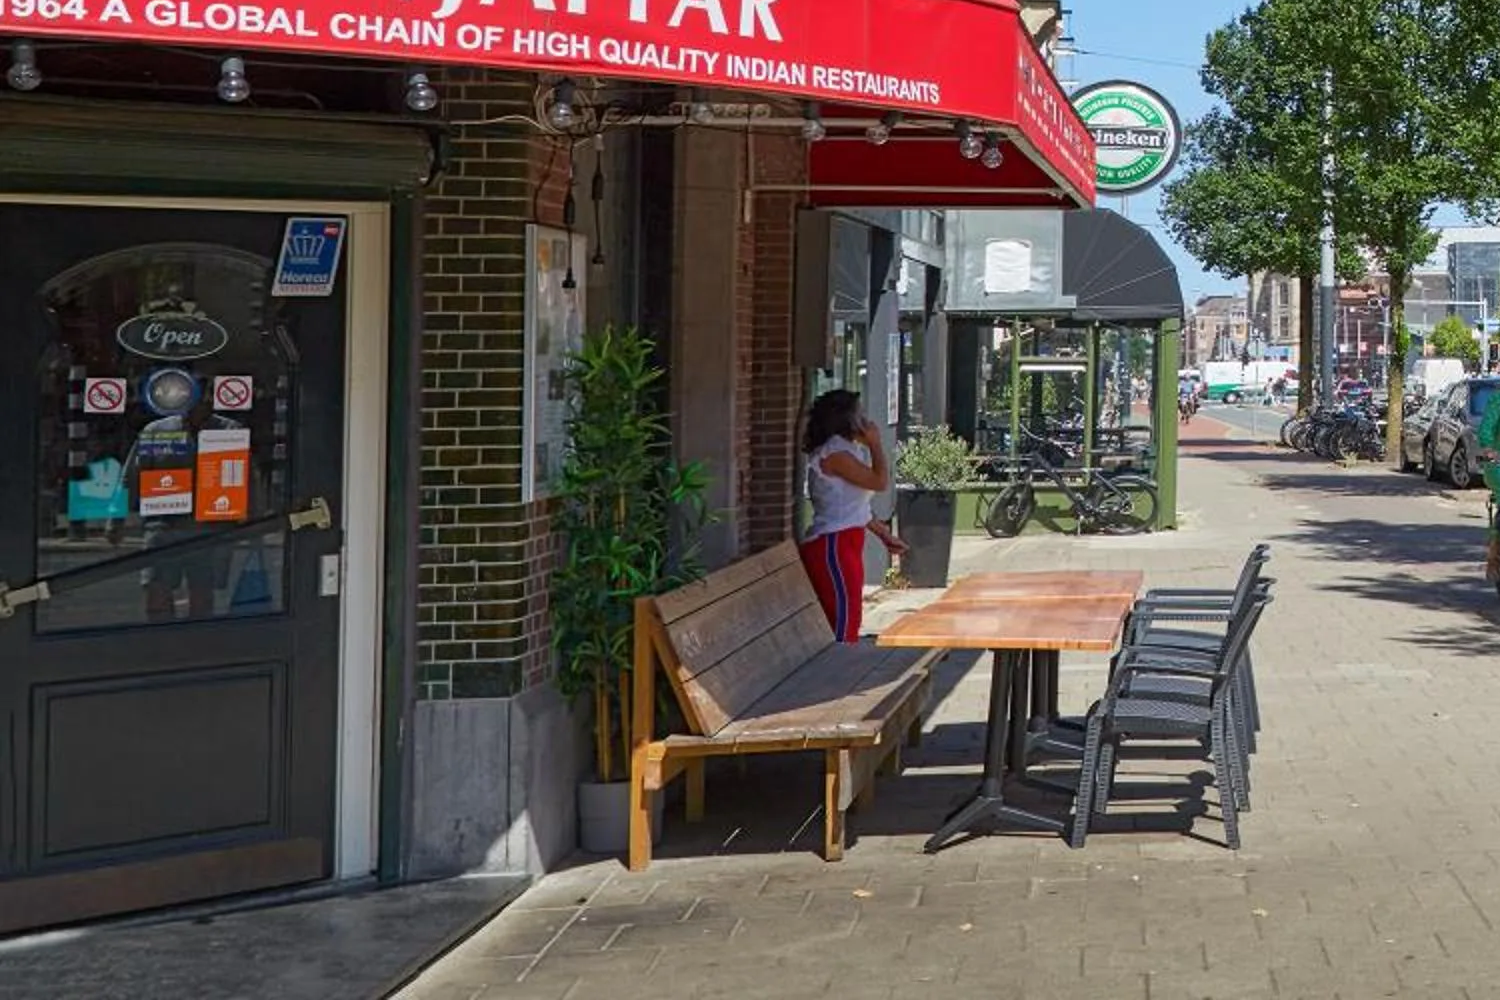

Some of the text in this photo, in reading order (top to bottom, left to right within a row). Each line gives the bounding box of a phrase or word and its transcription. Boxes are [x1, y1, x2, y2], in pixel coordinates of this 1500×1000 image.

[330, 13, 445, 48] CHAIN
[457, 24, 504, 53] OF
[513, 29, 591, 60] HIGH
[599, 37, 720, 77] QUALITY
[726, 55, 806, 87] INDIAN
[812, 67, 941, 105] RESTAURANTS
[1091, 129, 1161, 146] ineken
[144, 323, 203, 349] Open
